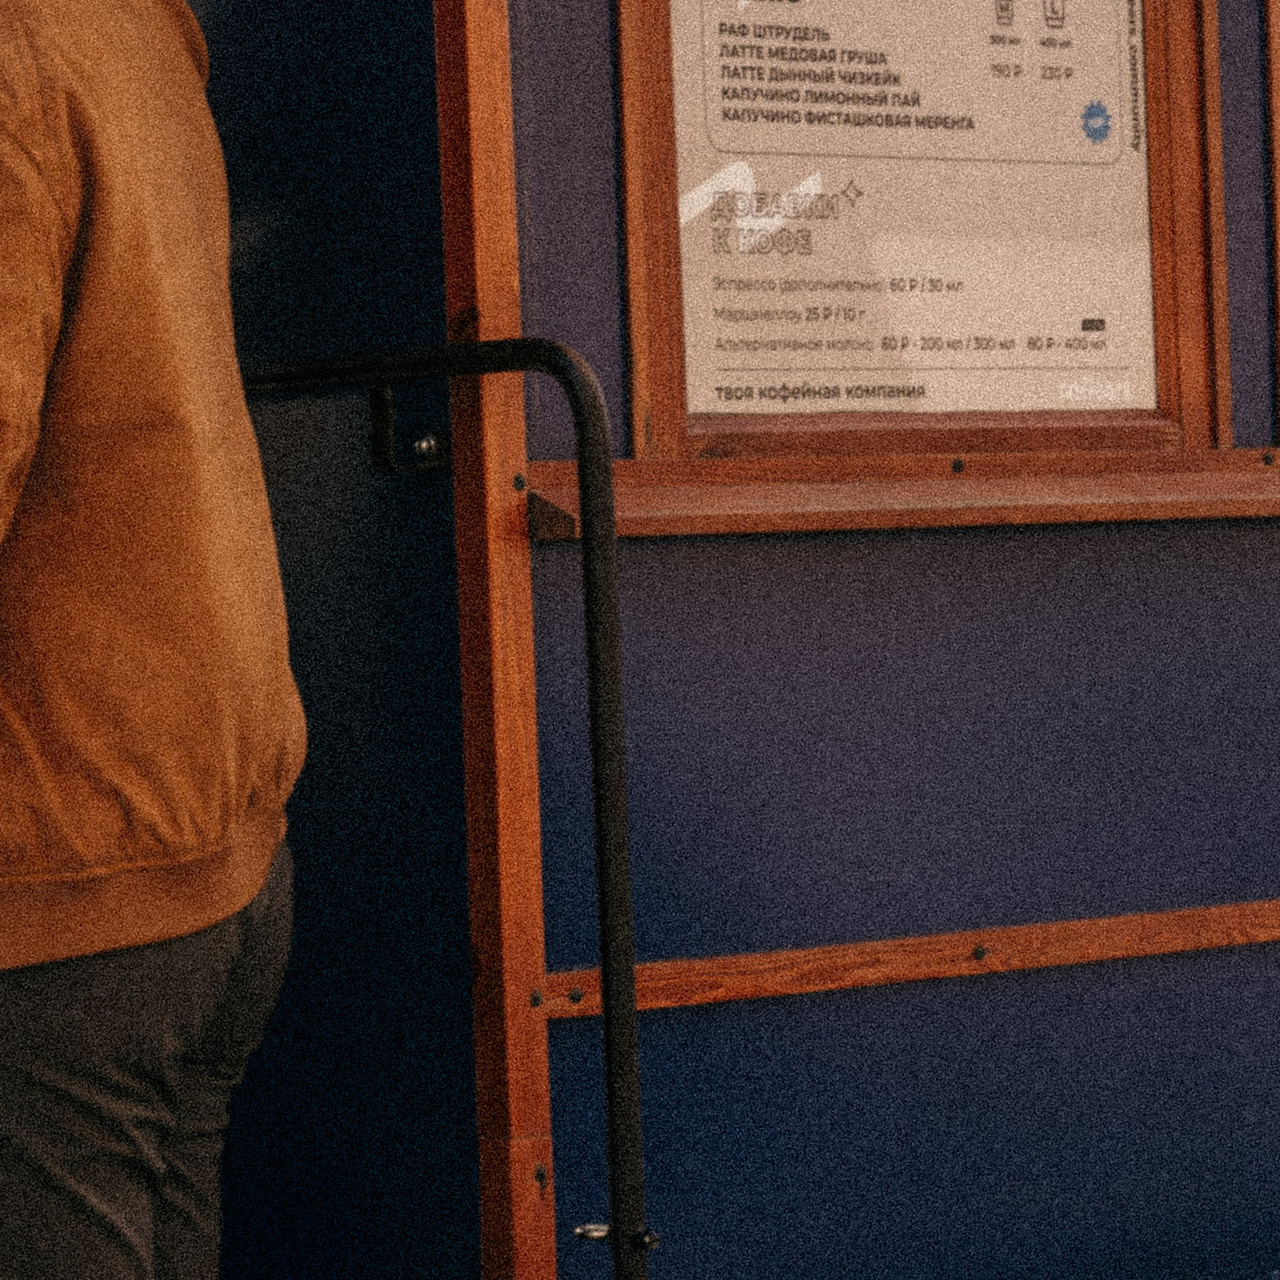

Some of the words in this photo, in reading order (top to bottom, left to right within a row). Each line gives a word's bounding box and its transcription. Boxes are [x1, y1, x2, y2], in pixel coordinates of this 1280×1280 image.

[718, 21, 750, 38] РАФ
[752, 23, 831, 42] ШТРУДЕЛЬ
[719, 43, 765, 60] ЛАТТЕ
[767, 47, 837, 63] МЕДОВАЯ
[839, 50, 888, 66] ГРУША
[720, 64, 765, 81] ЛАТТЕ
[767, 66, 836, 84] ДЫННЫЙ
[838, 69, 902, 87] ЧИЗКЕЙК
[721, 86, 801, 103] КАПУЧИНО
[802, 88, 888, 107] ЛИМОННЫЙ
[891, 90, 921, 108] ПАЙ
[722, 107, 801, 124] КАПУЧИНО
[803, 110, 912, 128] ФИСТАШКОВАЯ
[914, 114, 976, 131] МЕРЕНГА
[710, 190, 840, 222] ДОБАВКИ
[711, 227, 733, 256] К
[738, 227, 813, 257] КОФЕ
[715, 385, 754, 401] твоя
[758, 380, 841, 403] кофейная
[845, 384, 926, 401] компания
